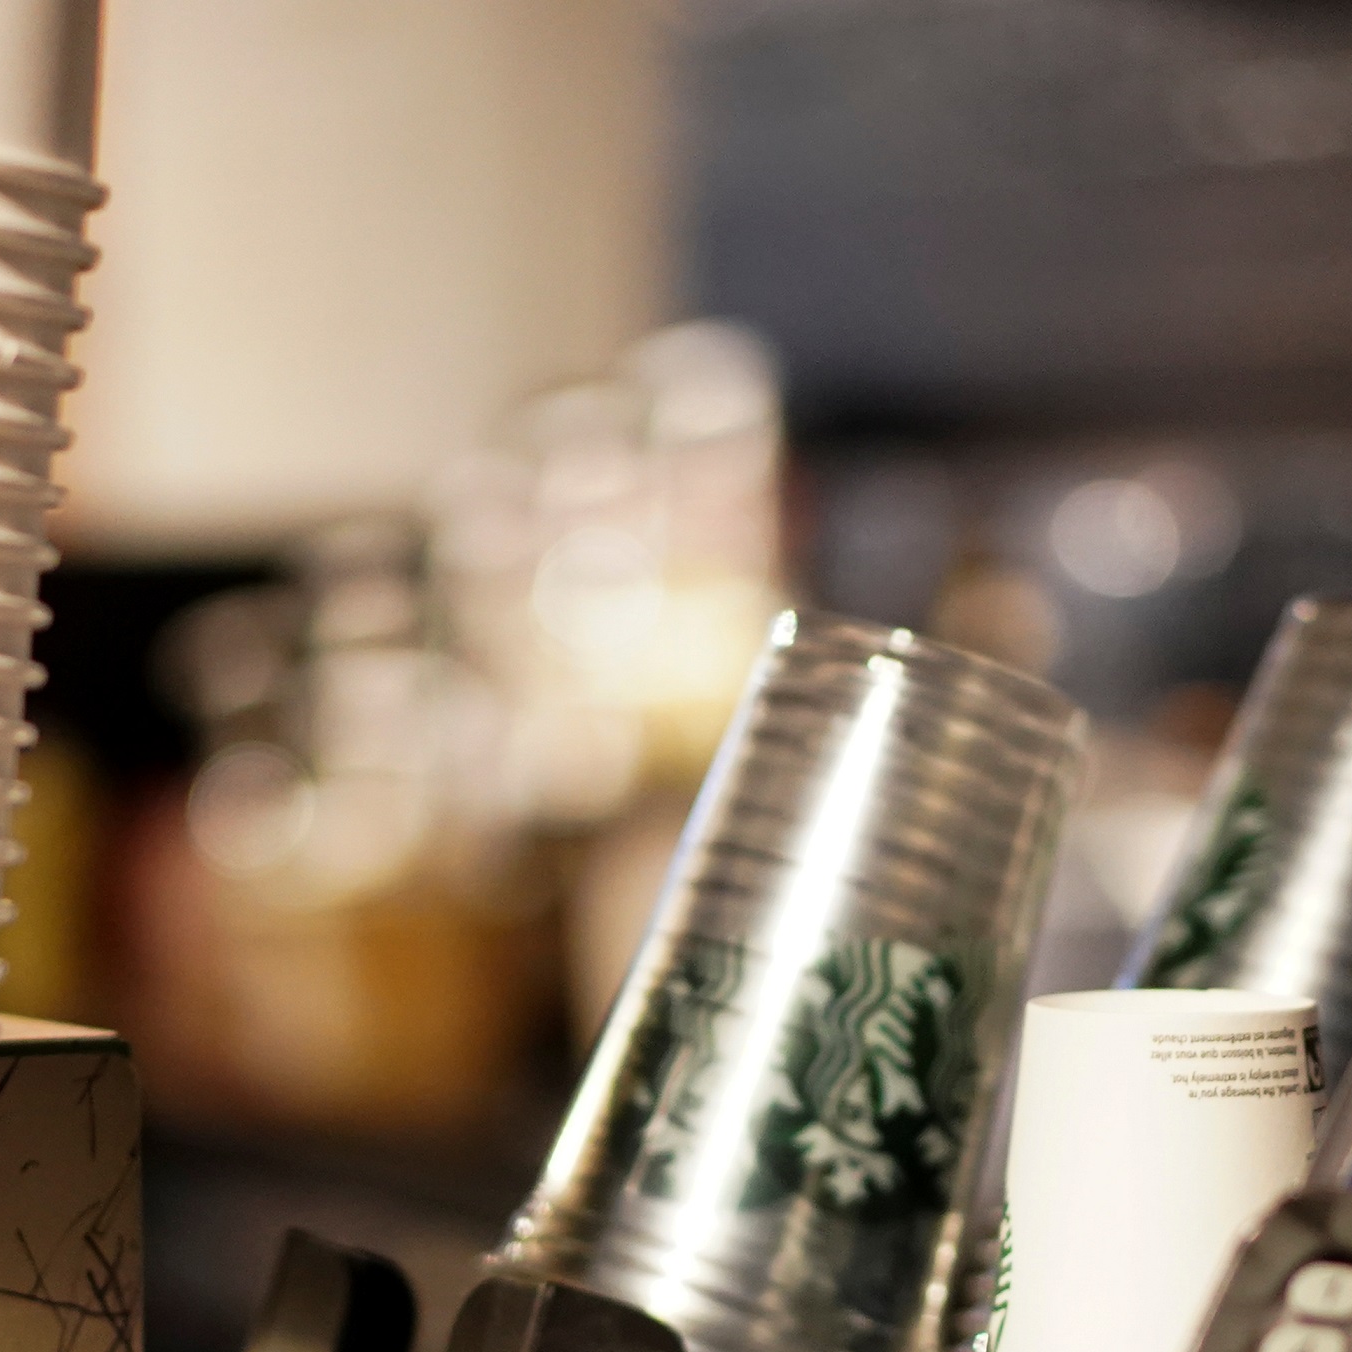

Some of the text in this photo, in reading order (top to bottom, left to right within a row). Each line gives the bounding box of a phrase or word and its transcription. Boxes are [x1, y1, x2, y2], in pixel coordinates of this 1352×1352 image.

[1174, 1050, 1198, 1060] vous
[1200, 1047, 1219, 1060] que
[1220, 1048, 1256, 1060] boisson
[1190, 1072, 1238, 1084] extremely
[1188, 1086, 1218, 1101] you're
[1220, 1086, 1261, 1100] beverage
